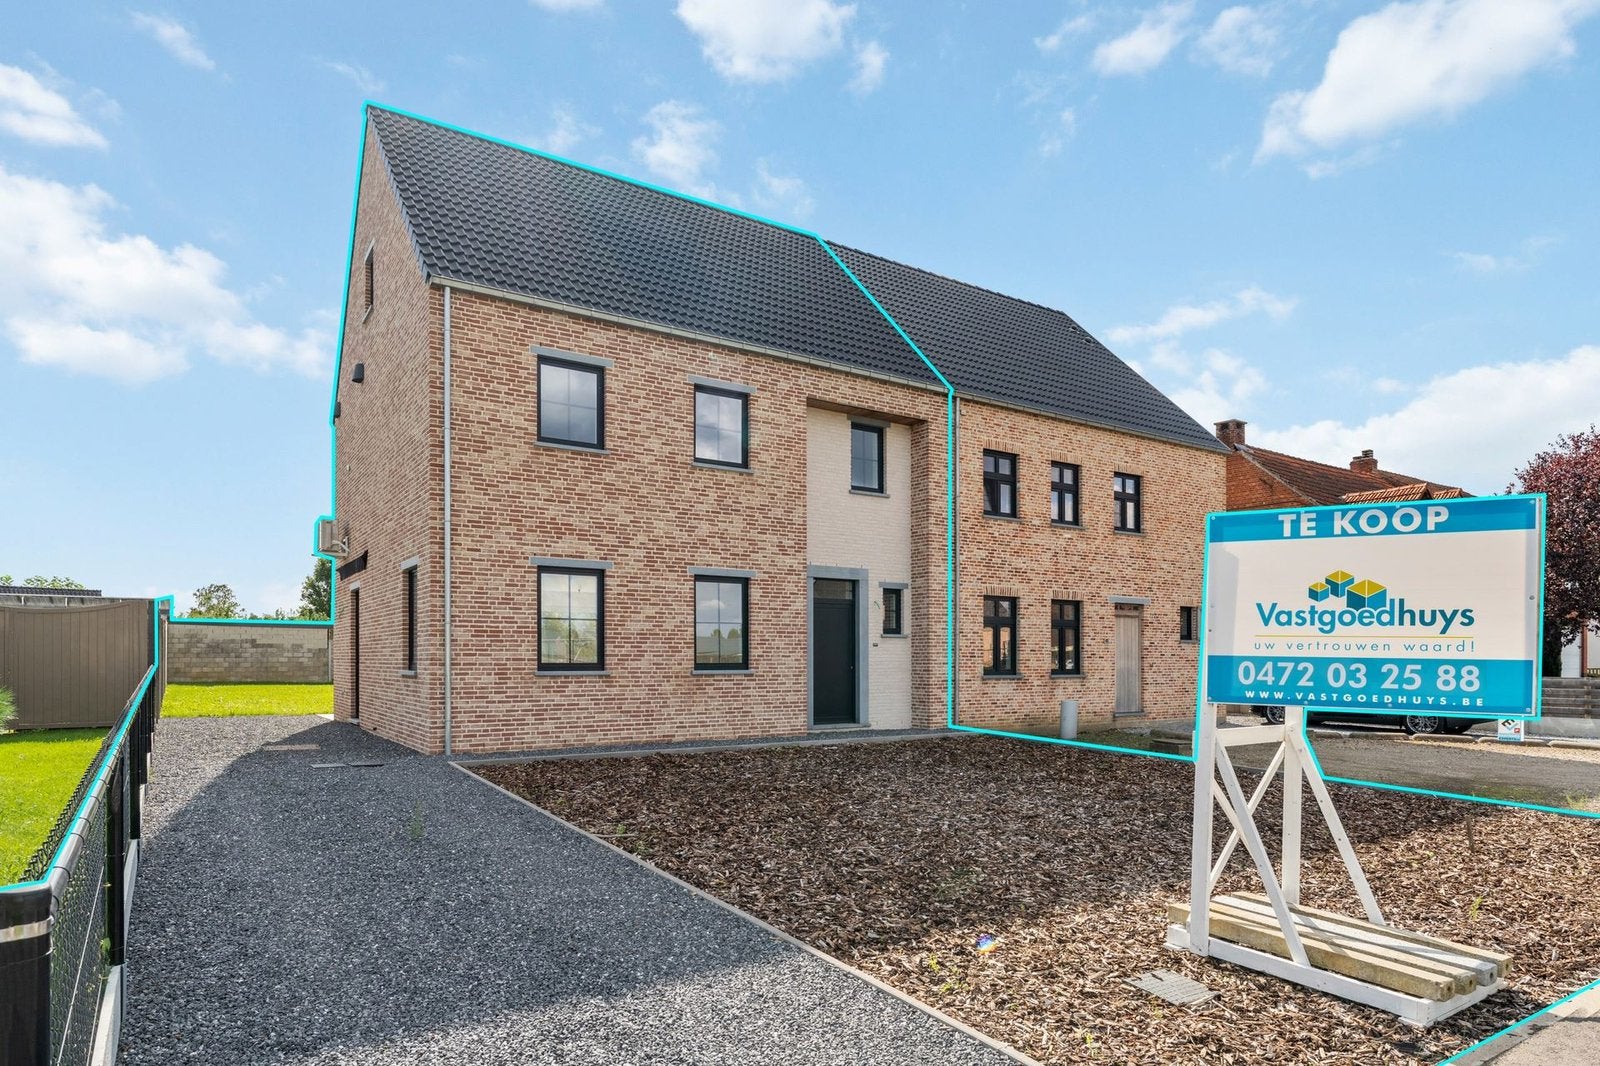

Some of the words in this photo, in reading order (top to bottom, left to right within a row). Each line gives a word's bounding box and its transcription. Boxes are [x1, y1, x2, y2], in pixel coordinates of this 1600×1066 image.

[1278, 513, 1317, 537] TE
[1333, 506, 1449, 535] KOOP
[1256, 598, 1475, 635] Vastgoedhuys
[1254, 642, 1275, 650] uw
[1286, 641, 1391, 652] vertrouwen
[1403, 640, 1475, 653] waard!
[1238, 661, 1314, 687] 0472
[1327, 662, 1368, 688] 03
[1380, 663, 1422, 690] 25
[1436, 664, 1480, 692] 88
[1245, 690, 1484, 706] WWW.VASTGOEDHUYS.BE
